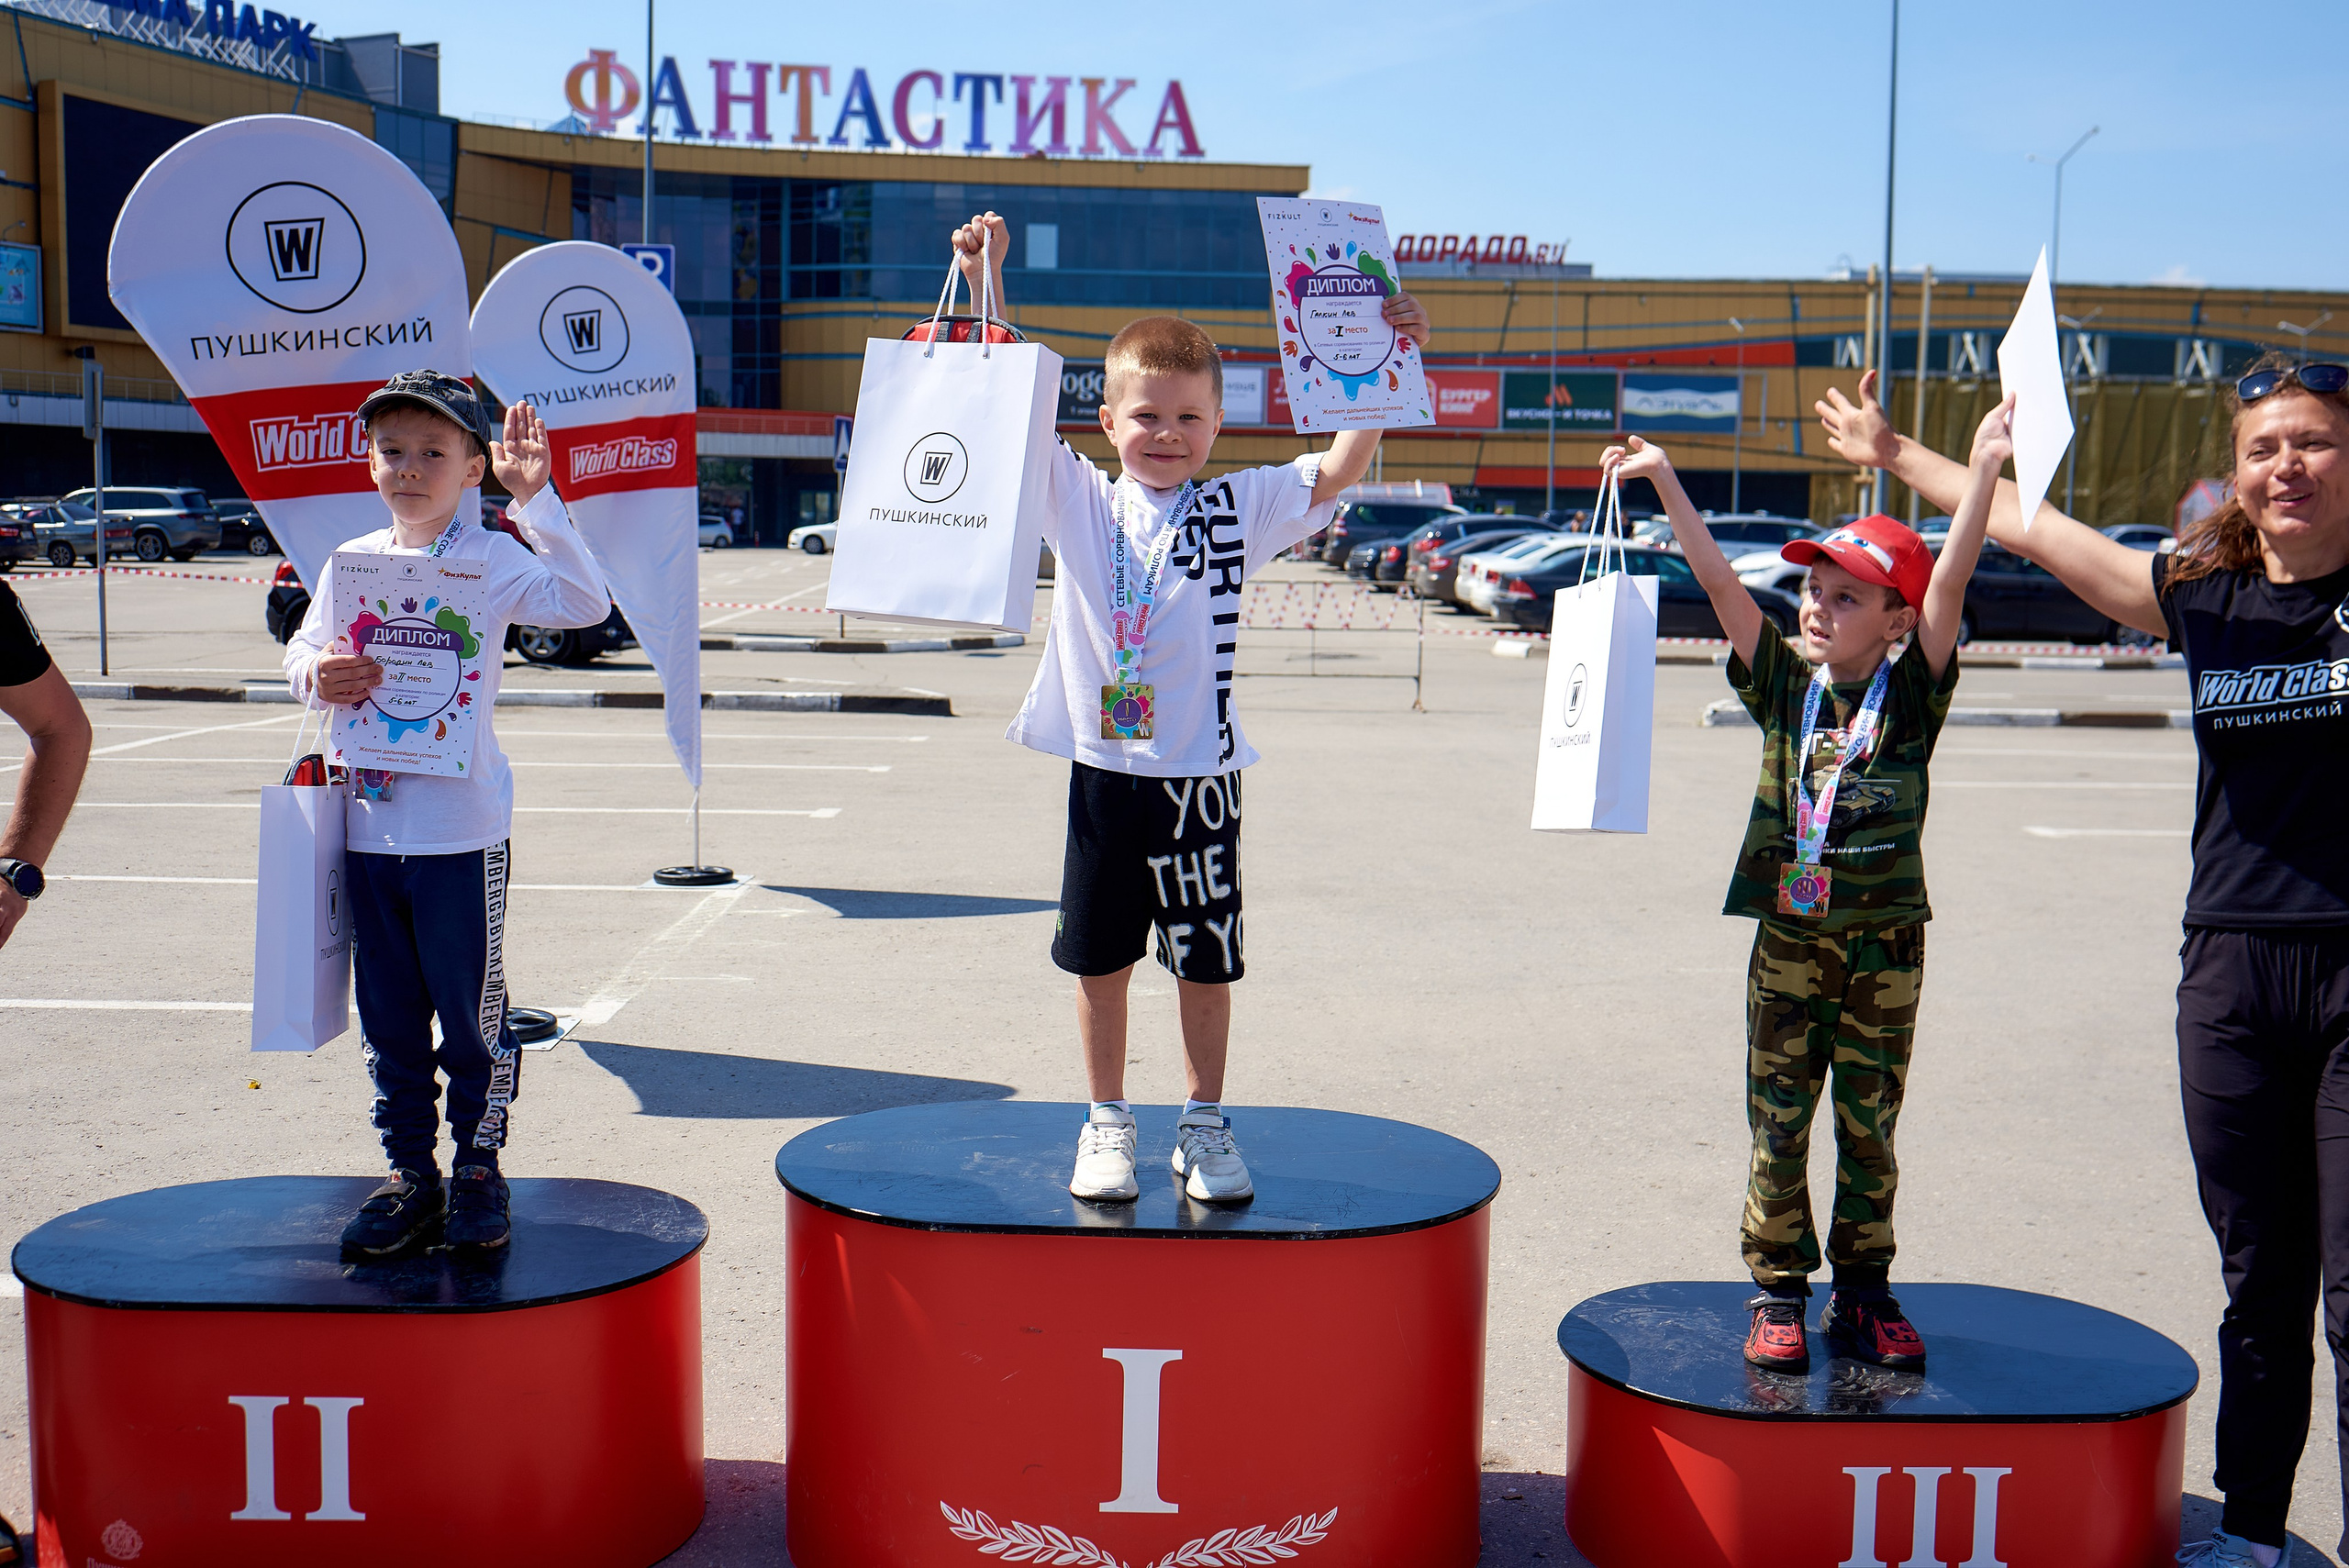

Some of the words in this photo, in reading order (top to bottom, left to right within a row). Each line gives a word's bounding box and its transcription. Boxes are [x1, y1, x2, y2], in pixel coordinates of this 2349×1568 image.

[207, 0, 318, 61] ПАРК
[564, 49, 1206, 158] ФАНТАСТИКА
[1307, 278, 1376, 296] ДИПЛОМ
[190, 317, 433, 361] ПУШКИНСКИЙ
[524, 373, 676, 407] ПУШКИНСКИЙ
[257, 418, 345, 465] World
[573, 442, 618, 478] World
[619, 439, 675, 472] Class
[869, 507, 988, 529] ПУШКИНСКИЙ
[1116, 495, 1125, 562] СОРЕВНОВАНИЯ
[340, 565, 380, 574] FIZKULT
[443, 572, 482, 581] ФизКульт
[1116, 564, 1125, 607] СЕТЕВЫЕ
[1143, 548, 1164, 595] РОЛИКАМ
[372, 628, 451, 647] ДИПЛОМ
[392, 650, 431, 658] награждается
[407, 675, 431, 684] место
[2199, 671, 2282, 707] World
[2213, 701, 2342, 729] ПУШКИНСКИЙ
[383, 749, 417, 757] дальнейших
[1549, 731, 1591, 748] ПУШКИНСКИЙ
[1837, 846, 1861, 854] НАШИ
[1862, 842, 1895, 853] БЫСТРЫ
[1147, 844, 1230, 907] THE
[1098, 1348, 1183, 1514] I
[228, 1396, 365, 1520] II
[1838, 1467, 2012, 1568] III
[2210, 1531, 2228, 1545] HOKA
